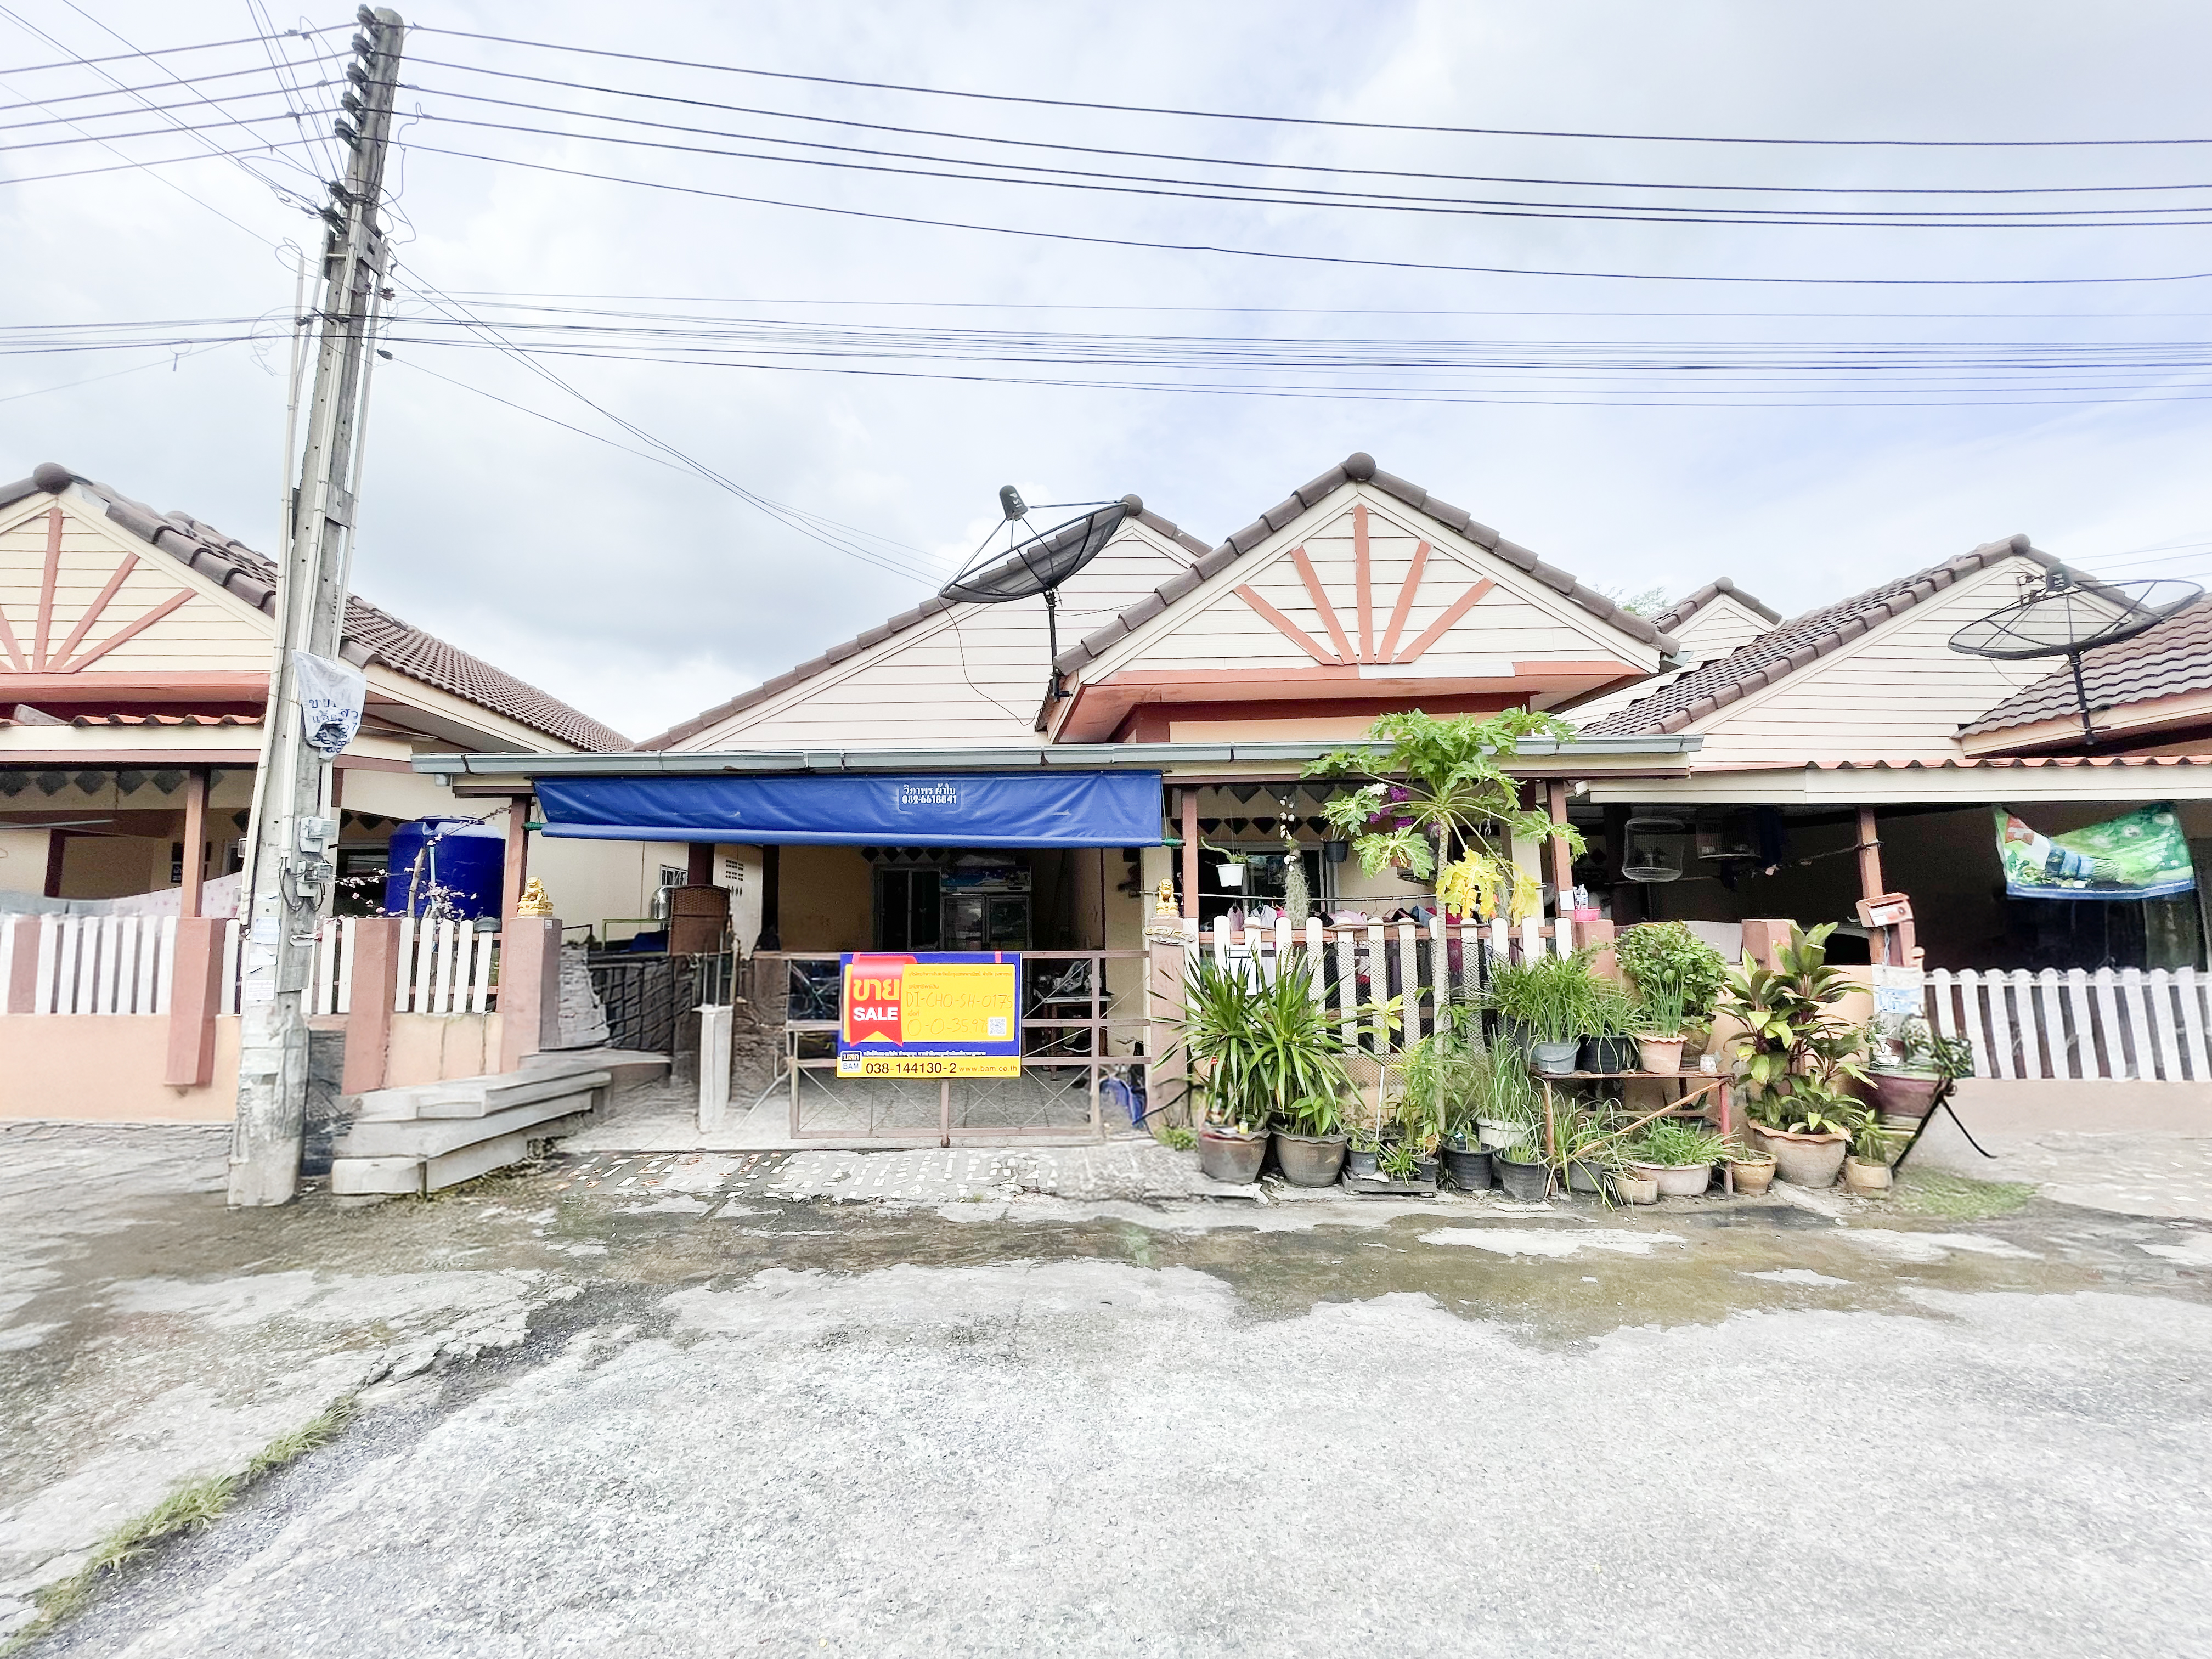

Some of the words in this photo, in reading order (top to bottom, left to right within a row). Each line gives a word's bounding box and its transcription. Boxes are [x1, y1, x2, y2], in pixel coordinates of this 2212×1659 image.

[854, 979, 900, 1001] ขาย
[854, 1007, 898, 1022] SALE
[866, 1063, 957, 1074] 038-144130-2
